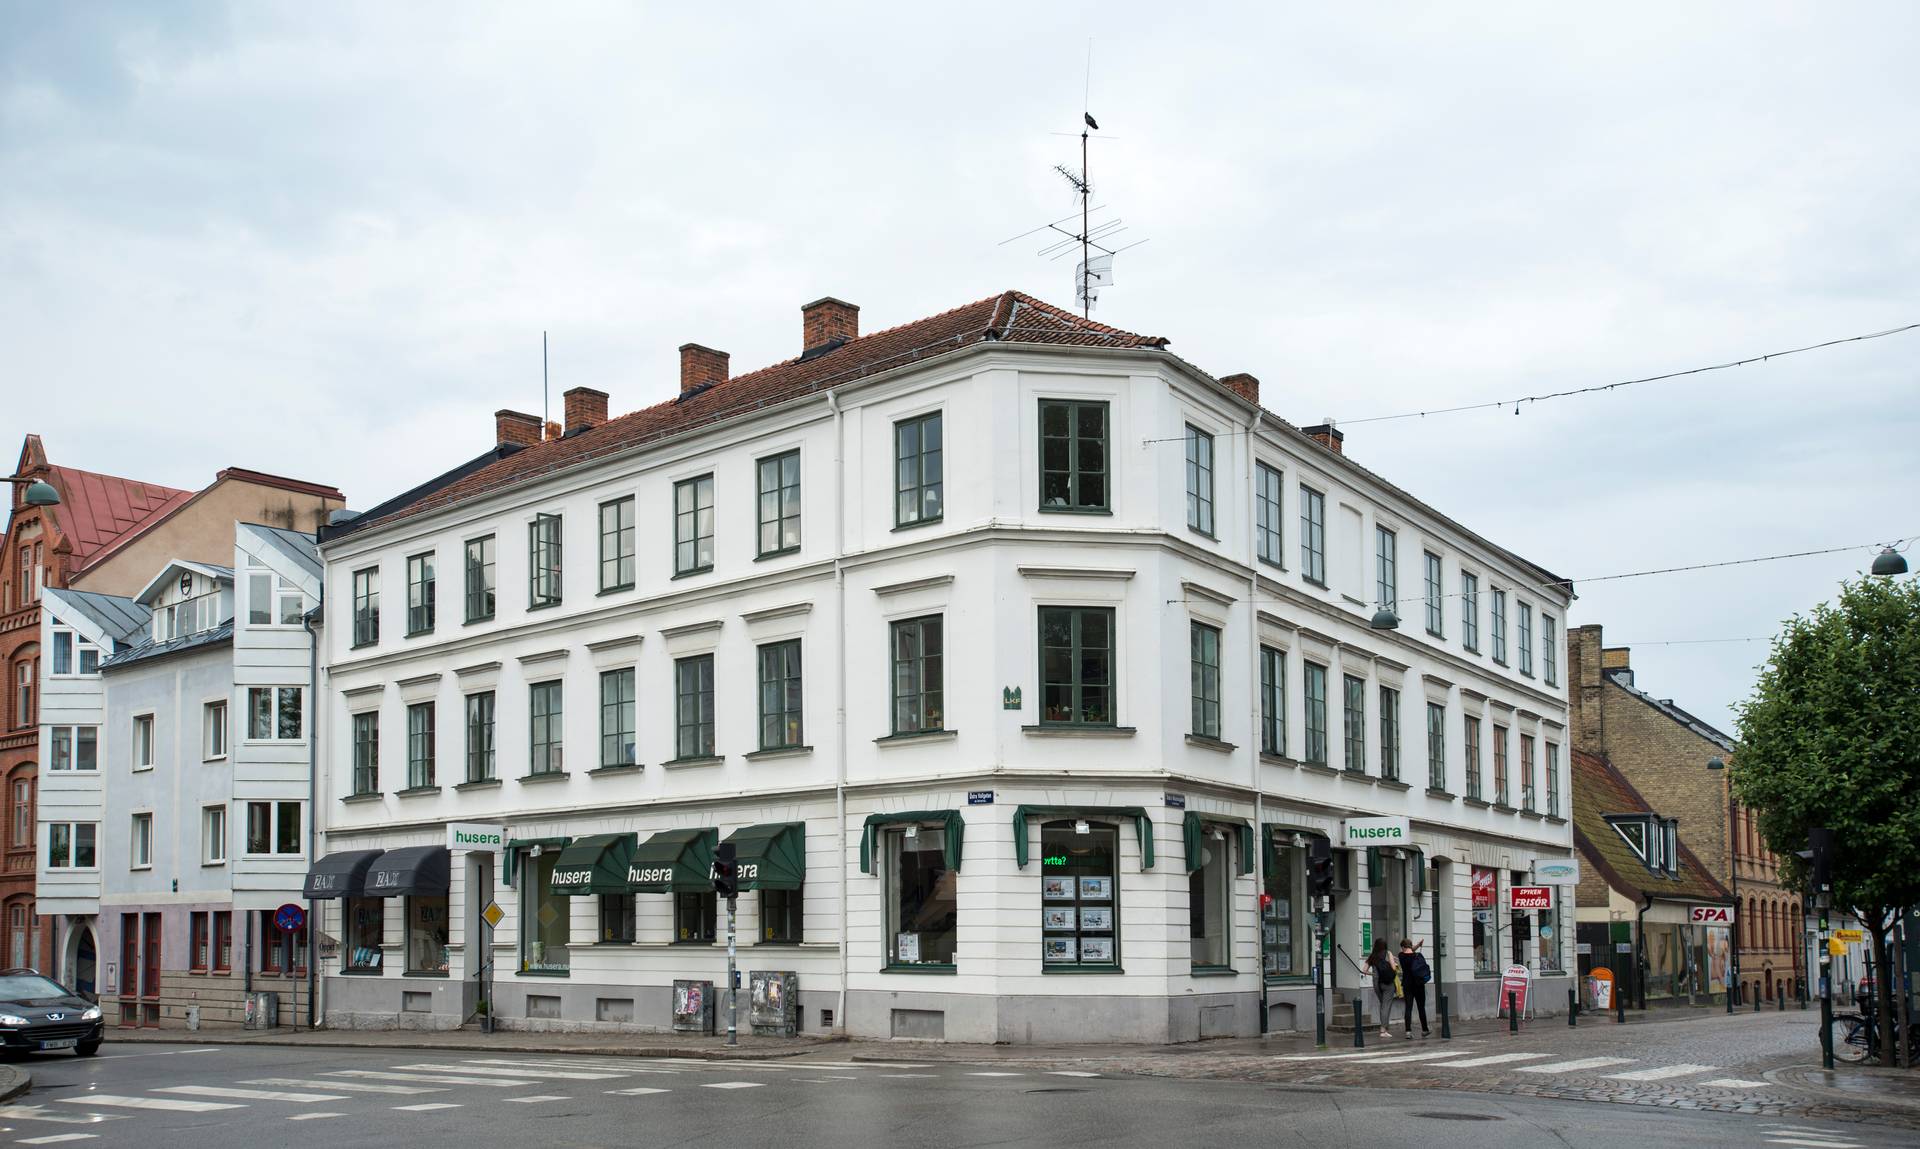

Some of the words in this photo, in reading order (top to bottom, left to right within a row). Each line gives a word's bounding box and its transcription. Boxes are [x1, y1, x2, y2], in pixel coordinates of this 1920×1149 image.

[456, 830, 500, 844] husera
[1349, 825, 1402, 839] husera
[551, 868, 592, 885] husera
[627, 865, 672, 882] husera
[709, 862, 758, 880] hera
[1514, 896, 1548, 907] FRISÖR
[1692, 908, 1729, 922] SPA
